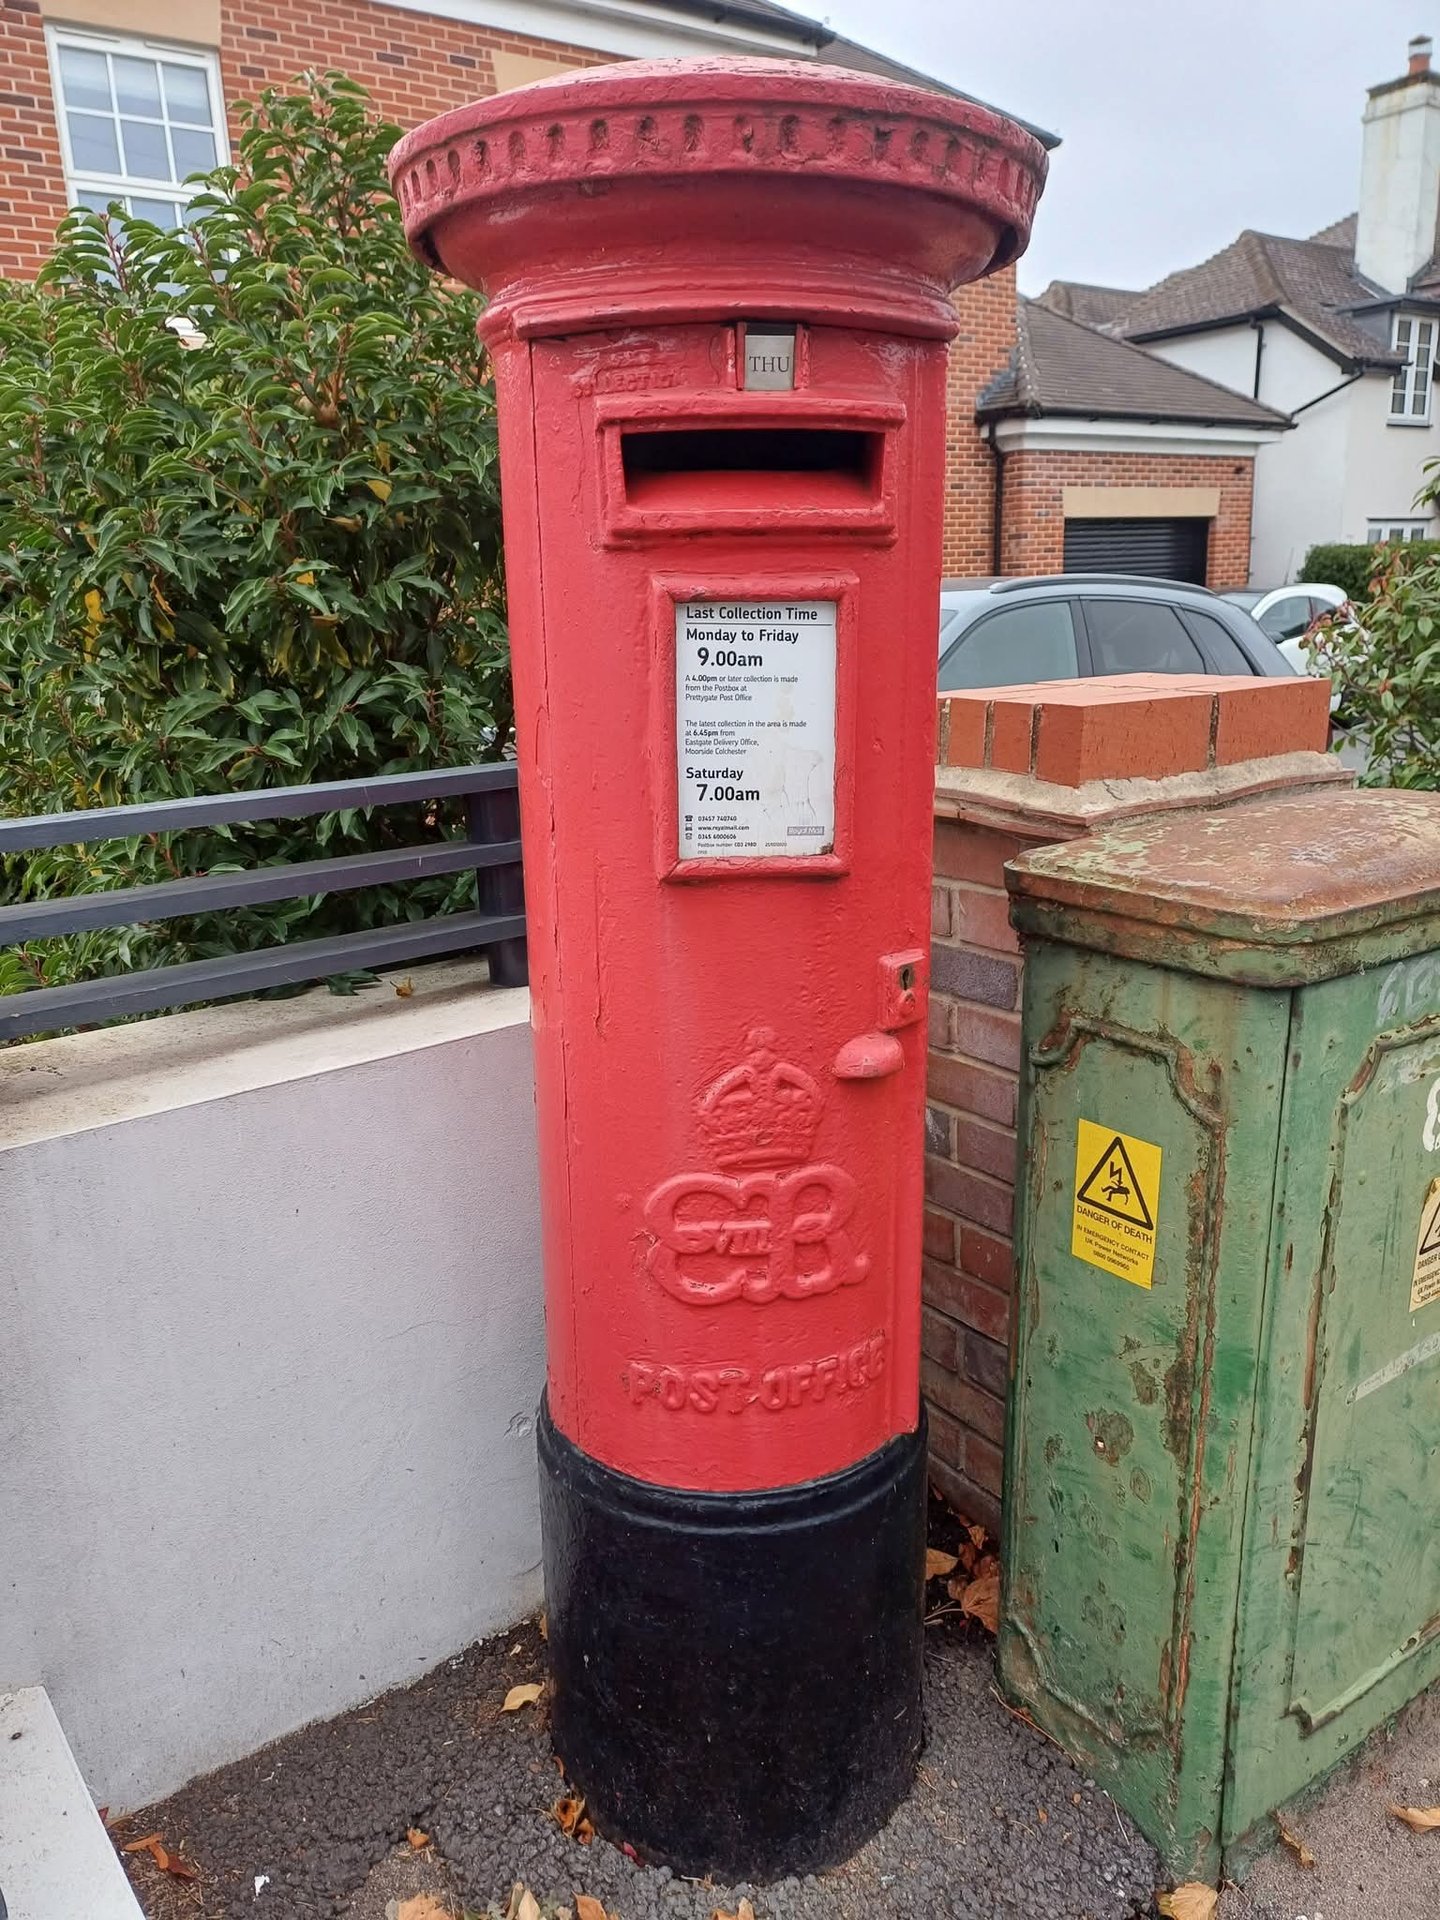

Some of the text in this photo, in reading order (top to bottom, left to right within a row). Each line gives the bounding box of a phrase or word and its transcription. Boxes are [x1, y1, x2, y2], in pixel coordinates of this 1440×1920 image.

[749, 356, 790, 373] THU
[686, 606, 818, 620] Last Collection Time
[686, 628, 799, 644] Monday to Friday
[697, 647, 763, 667] 9.00am
[685, 694, 718, 702] Prettygate
[685, 739, 759, 747] Eastgate Delivery Office,
[686, 767, 744, 781] Saturday
[696, 784, 760, 801] 7.00am
[1077, 1205, 1153, 1244] DANGER OF DEATH
[1083, 1227, 1119, 1247] EMERGENCY
[1120, 1244, 1149, 1260] CONTACT
